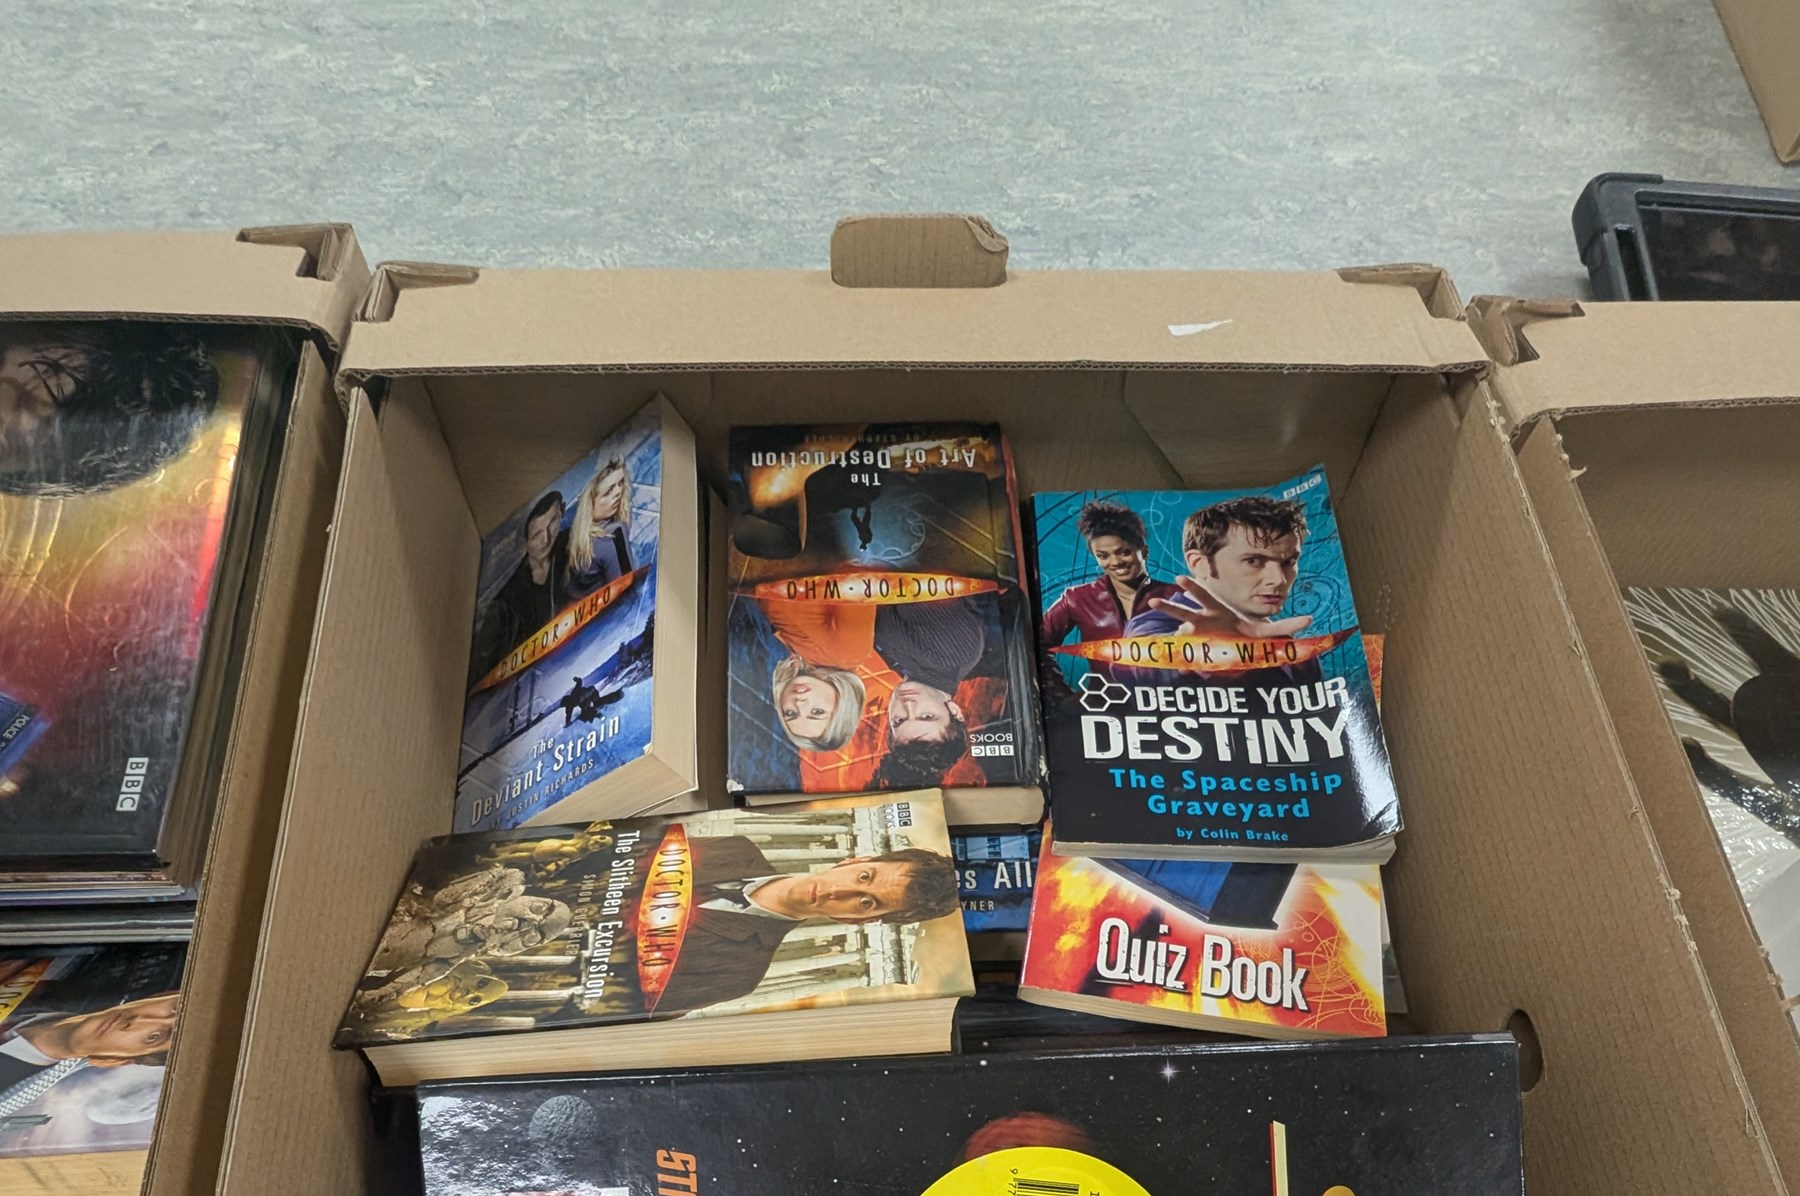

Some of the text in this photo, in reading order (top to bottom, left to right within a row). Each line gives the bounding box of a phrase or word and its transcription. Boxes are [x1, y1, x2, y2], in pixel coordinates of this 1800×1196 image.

[751, 448, 976, 469] Art of Destruction
[851, 473, 881, 486] The
[786, 578, 955, 600] DOCTOR WHO
[500, 586, 612, 678] DOCTOR WHO
[1112, 640, 1298, 663] DOCTOR WHO
[1135, 676, 1349, 714] DECIDE YOUR
[2, 714, 30, 739] POLICE
[970, 733, 1013, 743] BOOKS
[1081, 710, 1349, 765] DESTINY
[532, 737, 554, 759] The
[971, 745, 1014, 757] BBC
[116, 757, 149, 811] BBC
[471, 715, 620, 825] Deviant Strain
[1108, 767, 1342, 795] The Spaceship
[506, 791, 540, 820] JUSTIN
[544, 758, 594, 796] RICHARDS
[896, 802, 912, 827] BBC
[1147, 794, 1310, 822] Graveyard
[1176, 827, 1289, 842] by Colin Brake
[577, 874, 596, 903] SIMON
[994, 861, 1032, 889] All
[584, 830, 640, 998] The Slitheen Excursion
[641, 848, 688, 967] DOCTOR WHO
[961, 900, 994, 911] YNER
[1096, 917, 1308, 1011] Quiz Book
